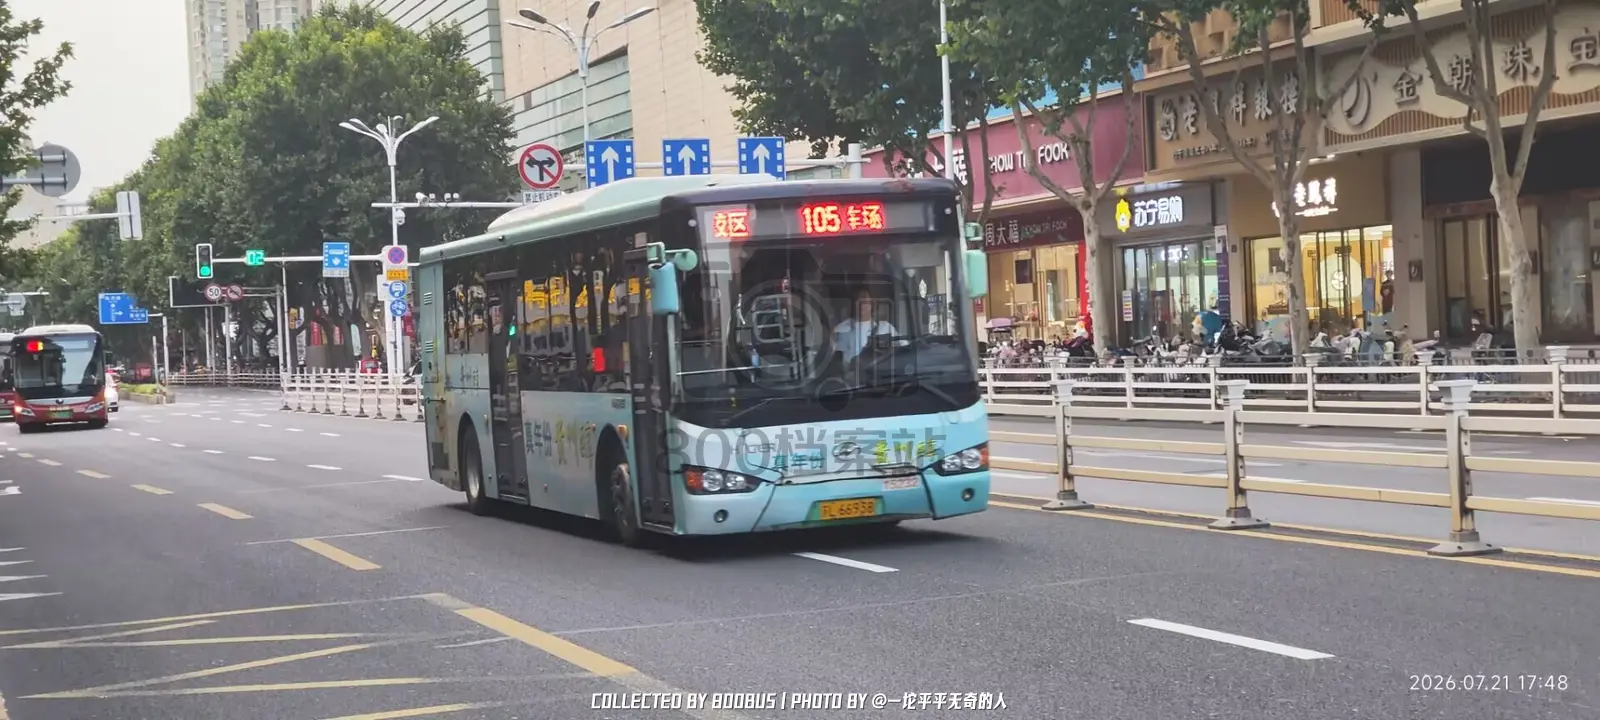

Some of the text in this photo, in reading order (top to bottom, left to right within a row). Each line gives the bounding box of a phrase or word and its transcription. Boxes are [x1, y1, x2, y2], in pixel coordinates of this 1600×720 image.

[1037, 141, 1070, 165] FOOK
[802, 205, 842, 234] 105
[1133, 195, 1184, 227] 苏宁易购
[985, 219, 1020, 247] 周大福
[249, 250, 265, 265] 02
[208, 287, 220, 297] 50
